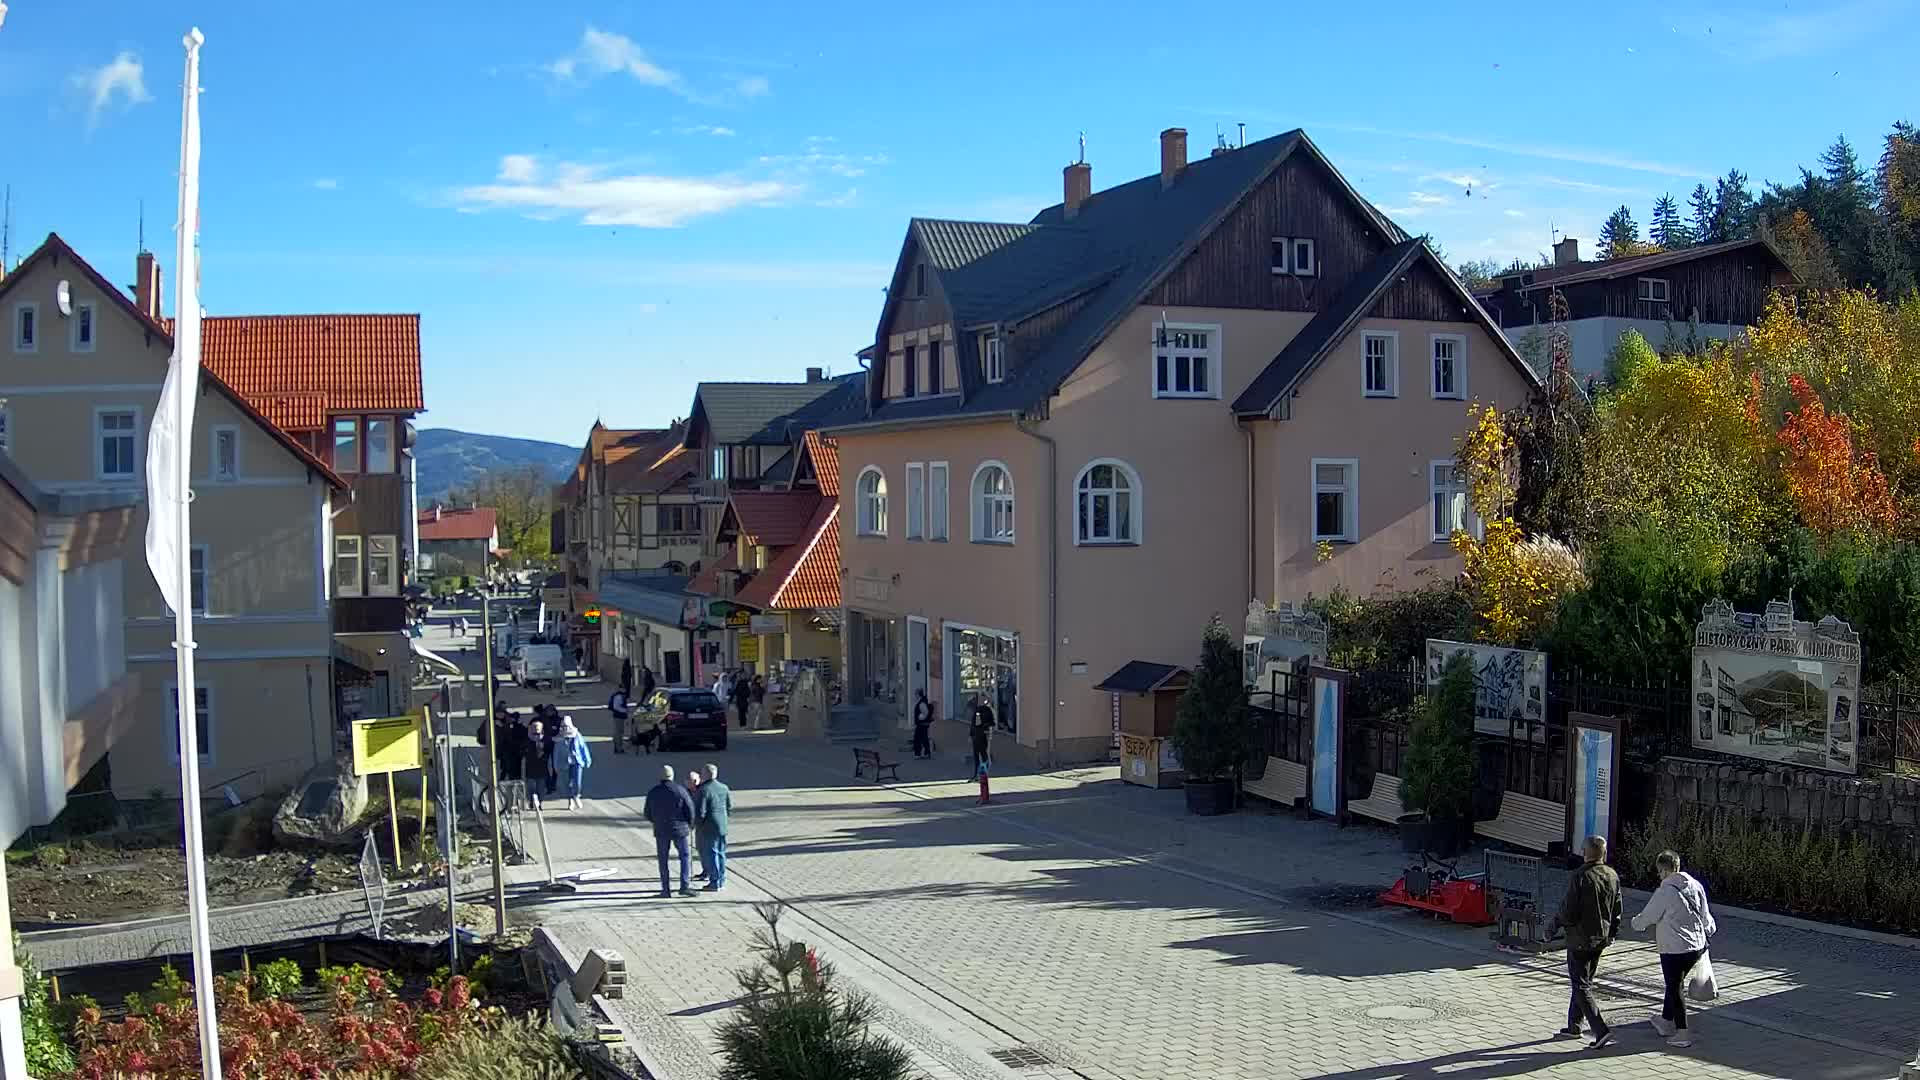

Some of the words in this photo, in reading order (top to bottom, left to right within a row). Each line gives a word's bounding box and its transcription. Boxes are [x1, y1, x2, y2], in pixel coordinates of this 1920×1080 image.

[1698, 631, 1767, 650] HISTORYCZNY
[1770, 638, 1799, 655] PARK
[1802, 640, 1860, 661] MINIATUR
